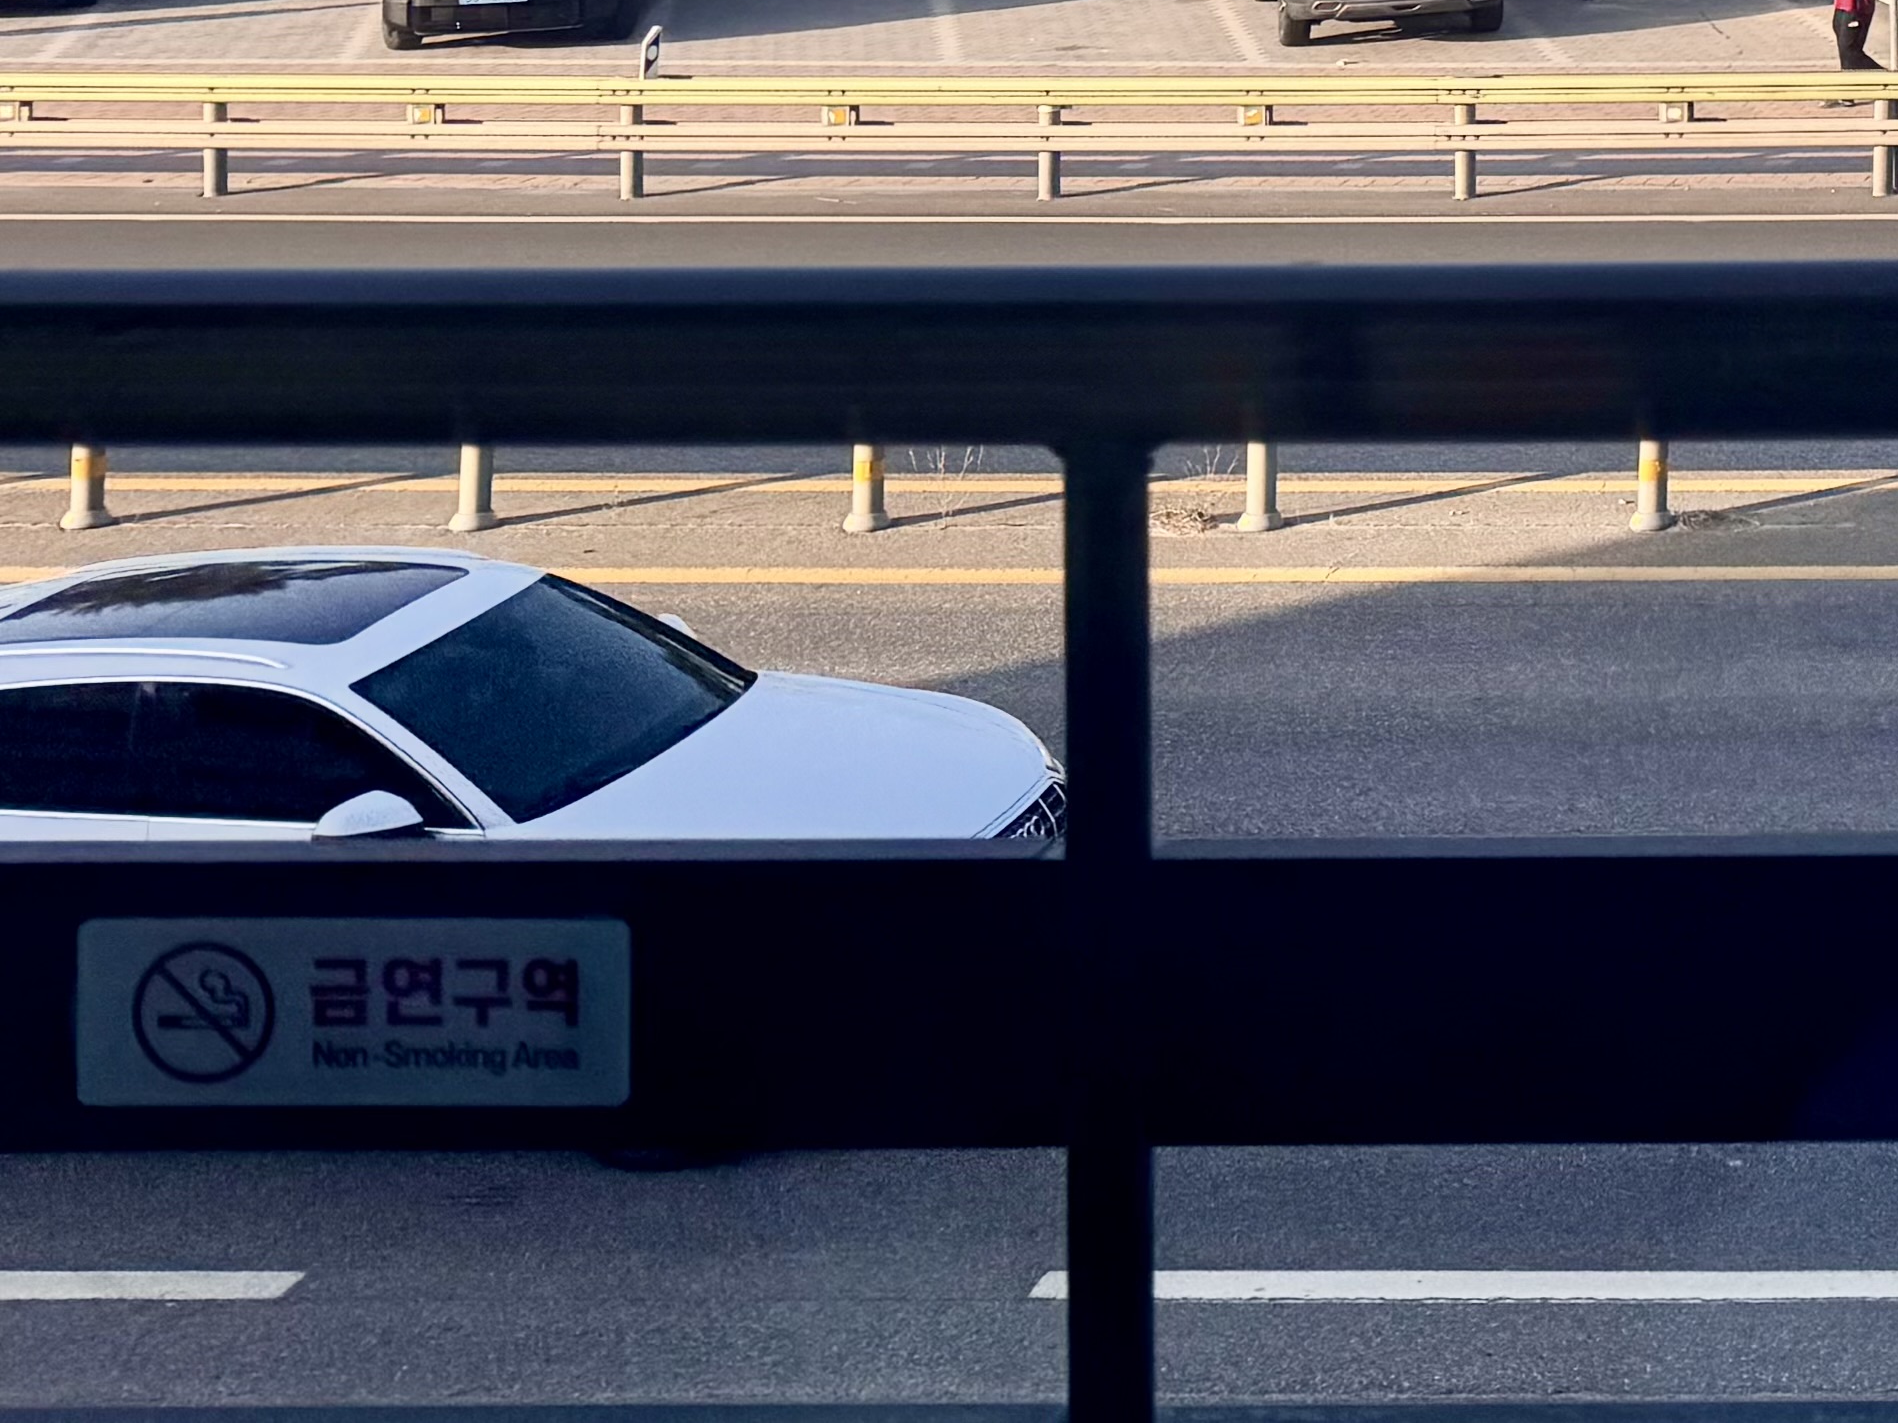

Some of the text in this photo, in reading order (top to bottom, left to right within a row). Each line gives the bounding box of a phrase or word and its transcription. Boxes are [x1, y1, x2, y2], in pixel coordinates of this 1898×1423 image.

[309, 957, 580, 1028] 금연구역
[312, 1039, 580, 1077] Non-Smoking Area
